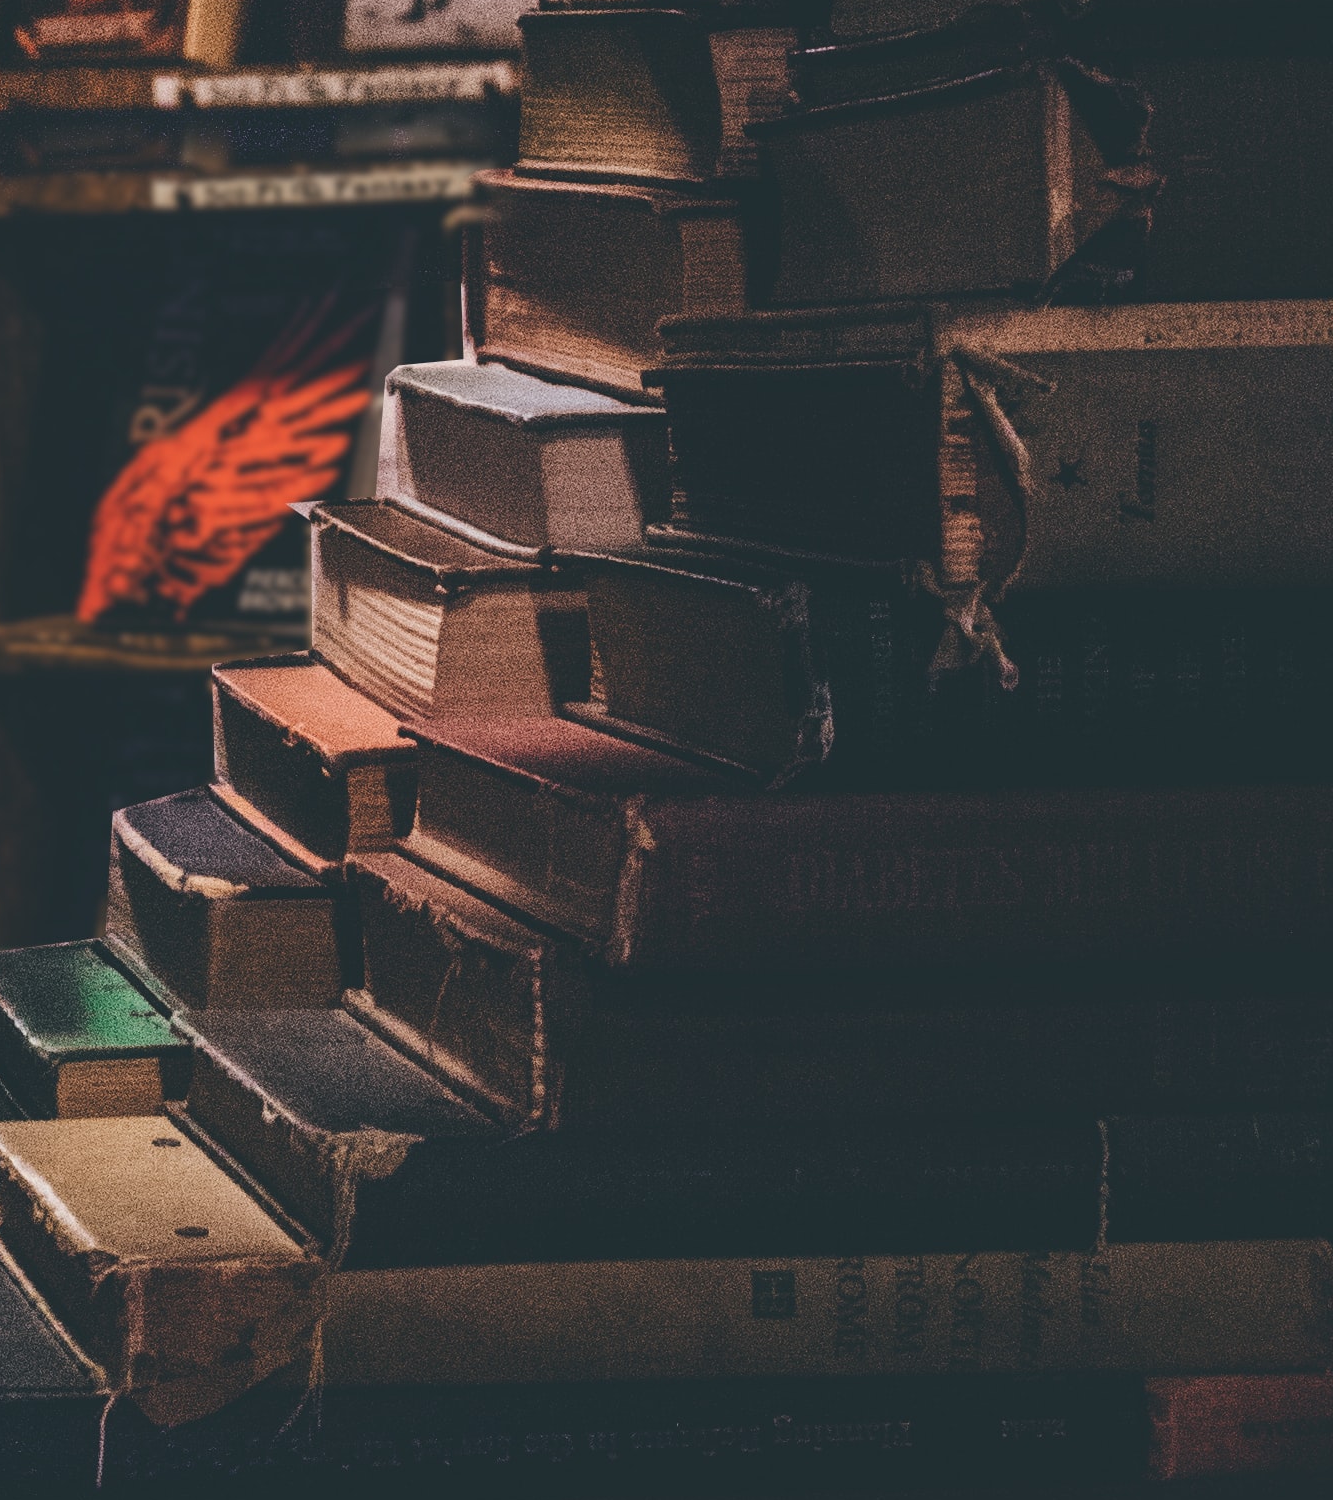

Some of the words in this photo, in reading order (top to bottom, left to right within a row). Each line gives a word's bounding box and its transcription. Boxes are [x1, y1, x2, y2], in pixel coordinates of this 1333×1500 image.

[834, 1255, 869, 1360] ROME
[520, 1430, 577, 1465] the
[769, 1412, 916, 1451] Planning
